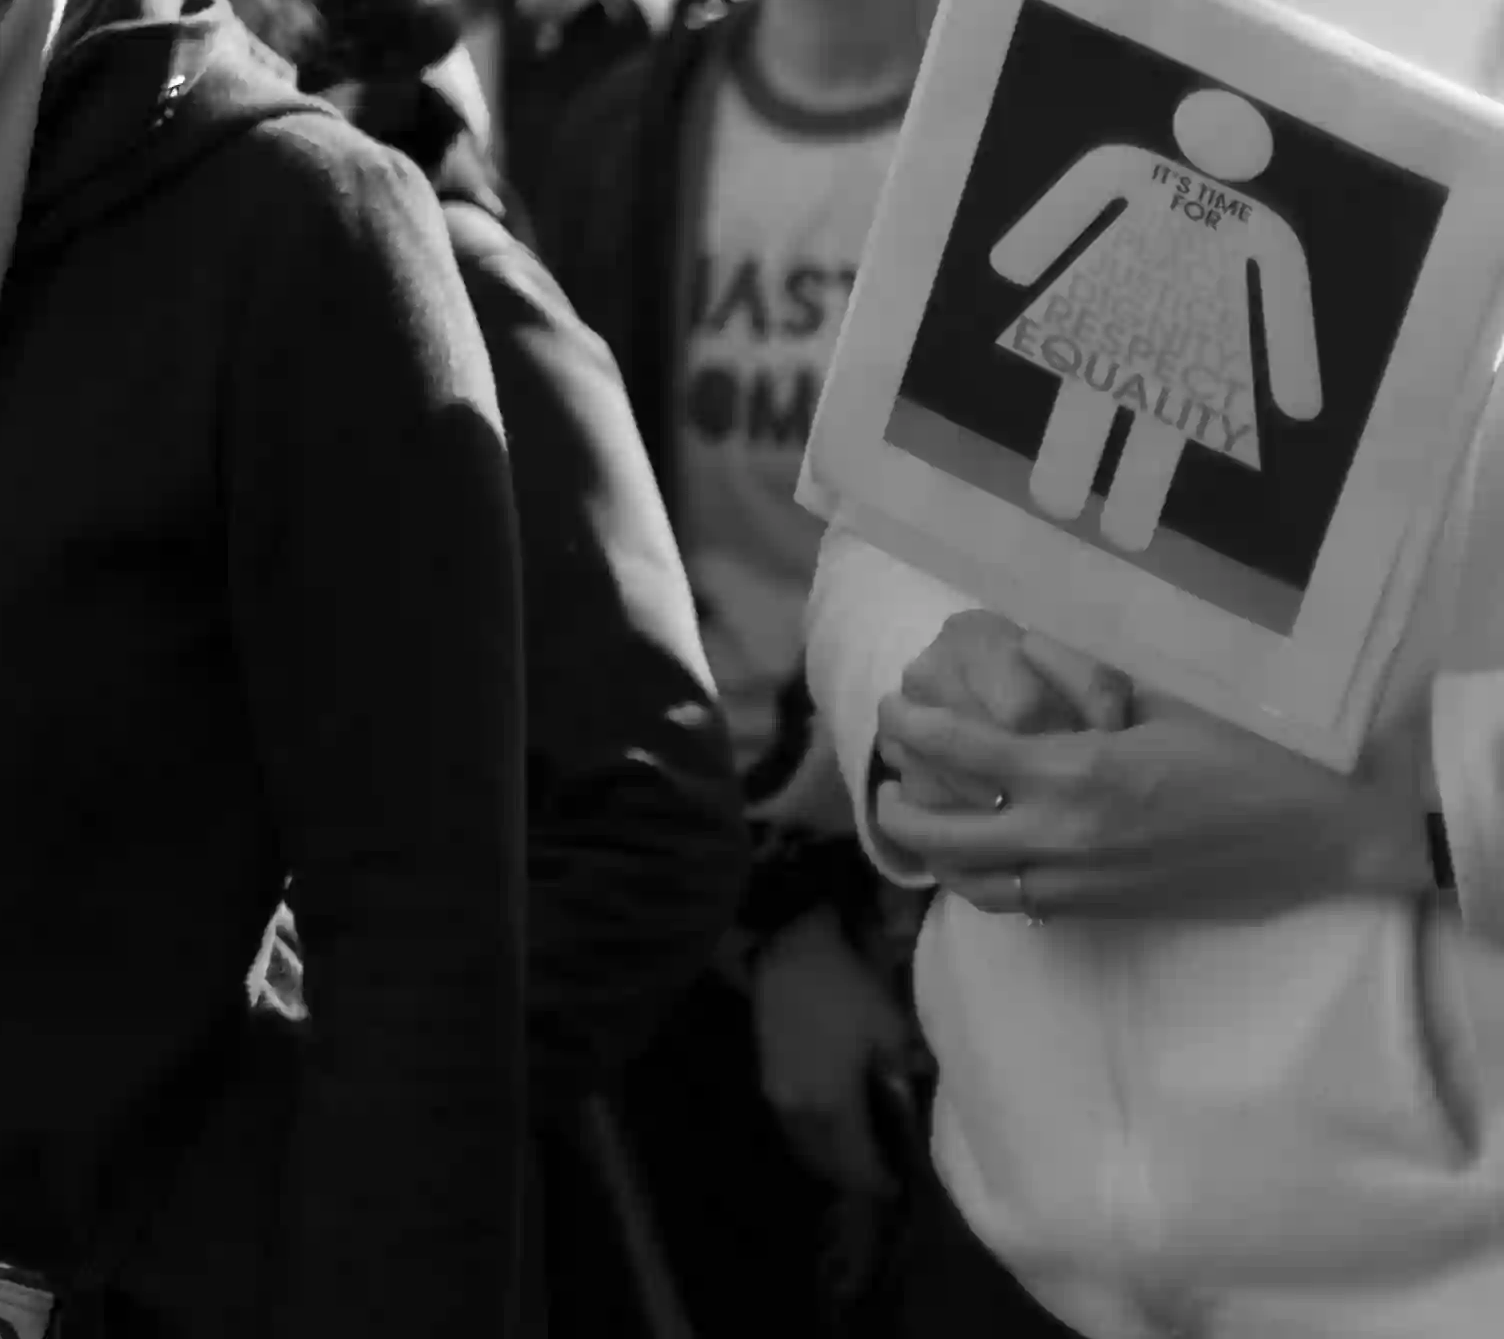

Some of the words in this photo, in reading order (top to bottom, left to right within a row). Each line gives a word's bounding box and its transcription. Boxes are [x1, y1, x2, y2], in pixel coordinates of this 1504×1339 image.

[1150, 162, 1192, 196] IT'S
[1196, 180, 1254, 225] TIME
[1169, 191, 1223, 232] FOR
[1011, 314, 1253, 453] EQUALITY
[1041, 292, 1250, 411] RESPECT
